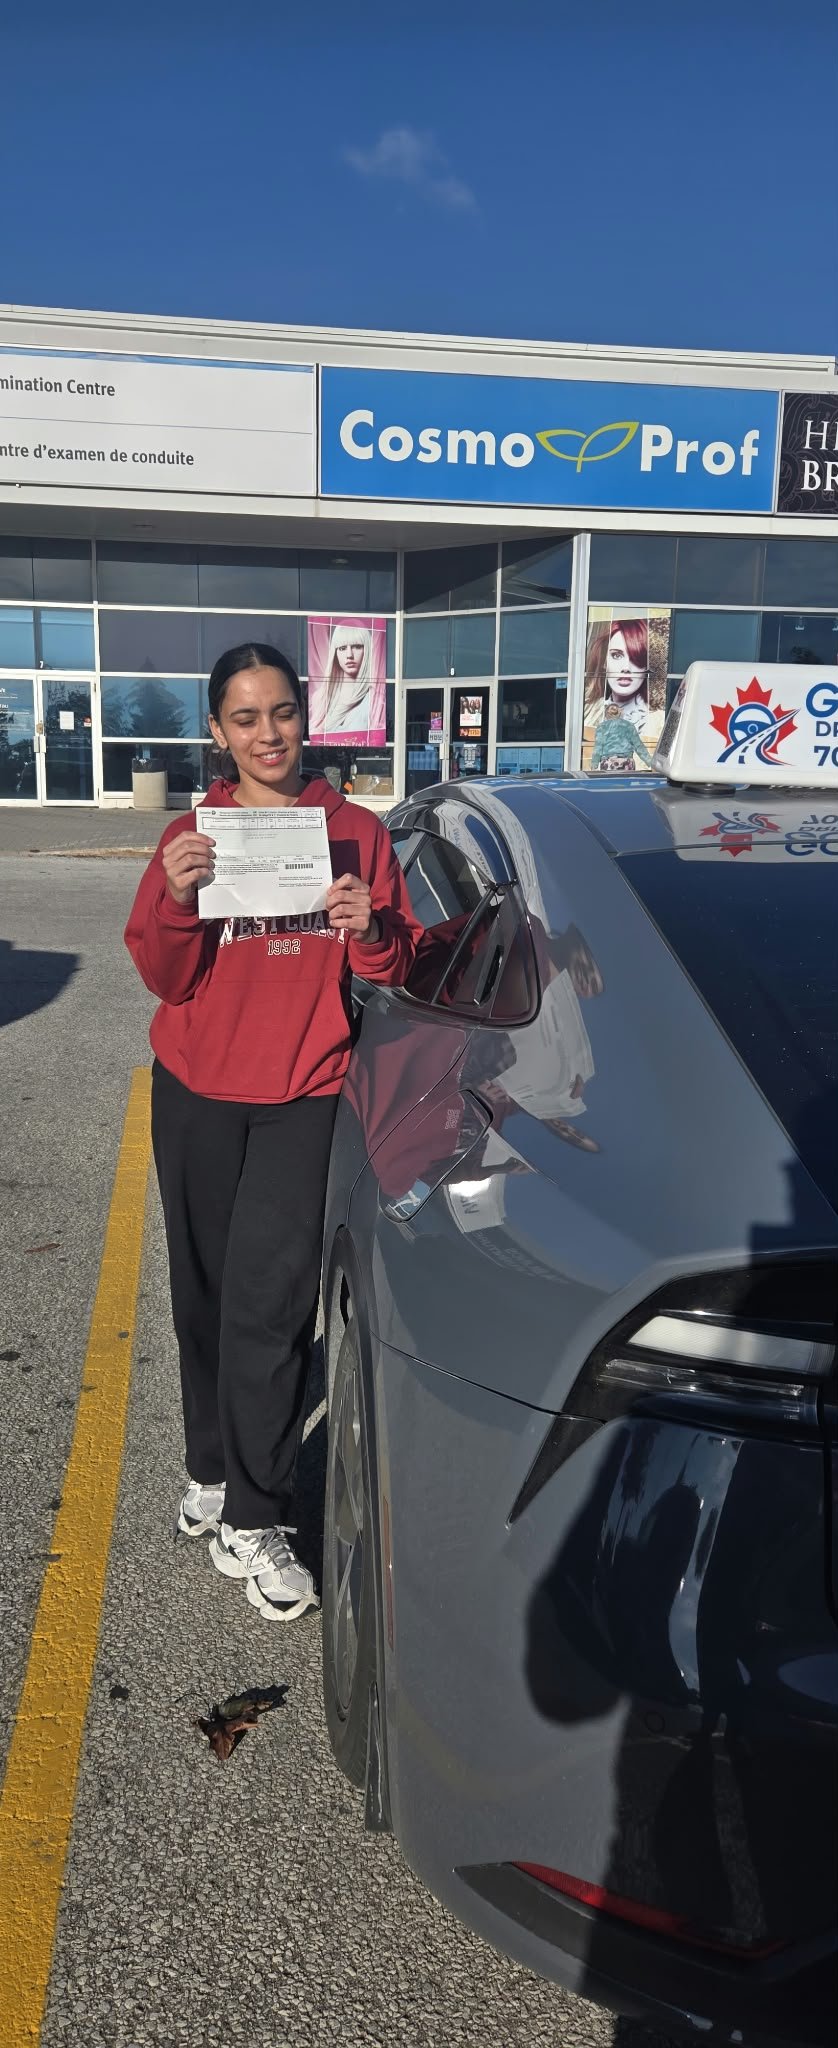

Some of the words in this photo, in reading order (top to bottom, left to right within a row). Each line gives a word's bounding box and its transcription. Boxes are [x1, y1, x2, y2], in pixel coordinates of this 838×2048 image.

[0, 374, 62, 393] mination
[67, 379, 115, 397] Centre
[339, 409, 535, 468] Cosmo
[640, 423, 760, 476] Prof
[0, 443, 29, 457] ntre
[33, 444, 106, 462] d’examen
[109, 449, 128, 463] de
[131, 450, 194, 466] conduite
[267, 938, 301, 955] 1992
